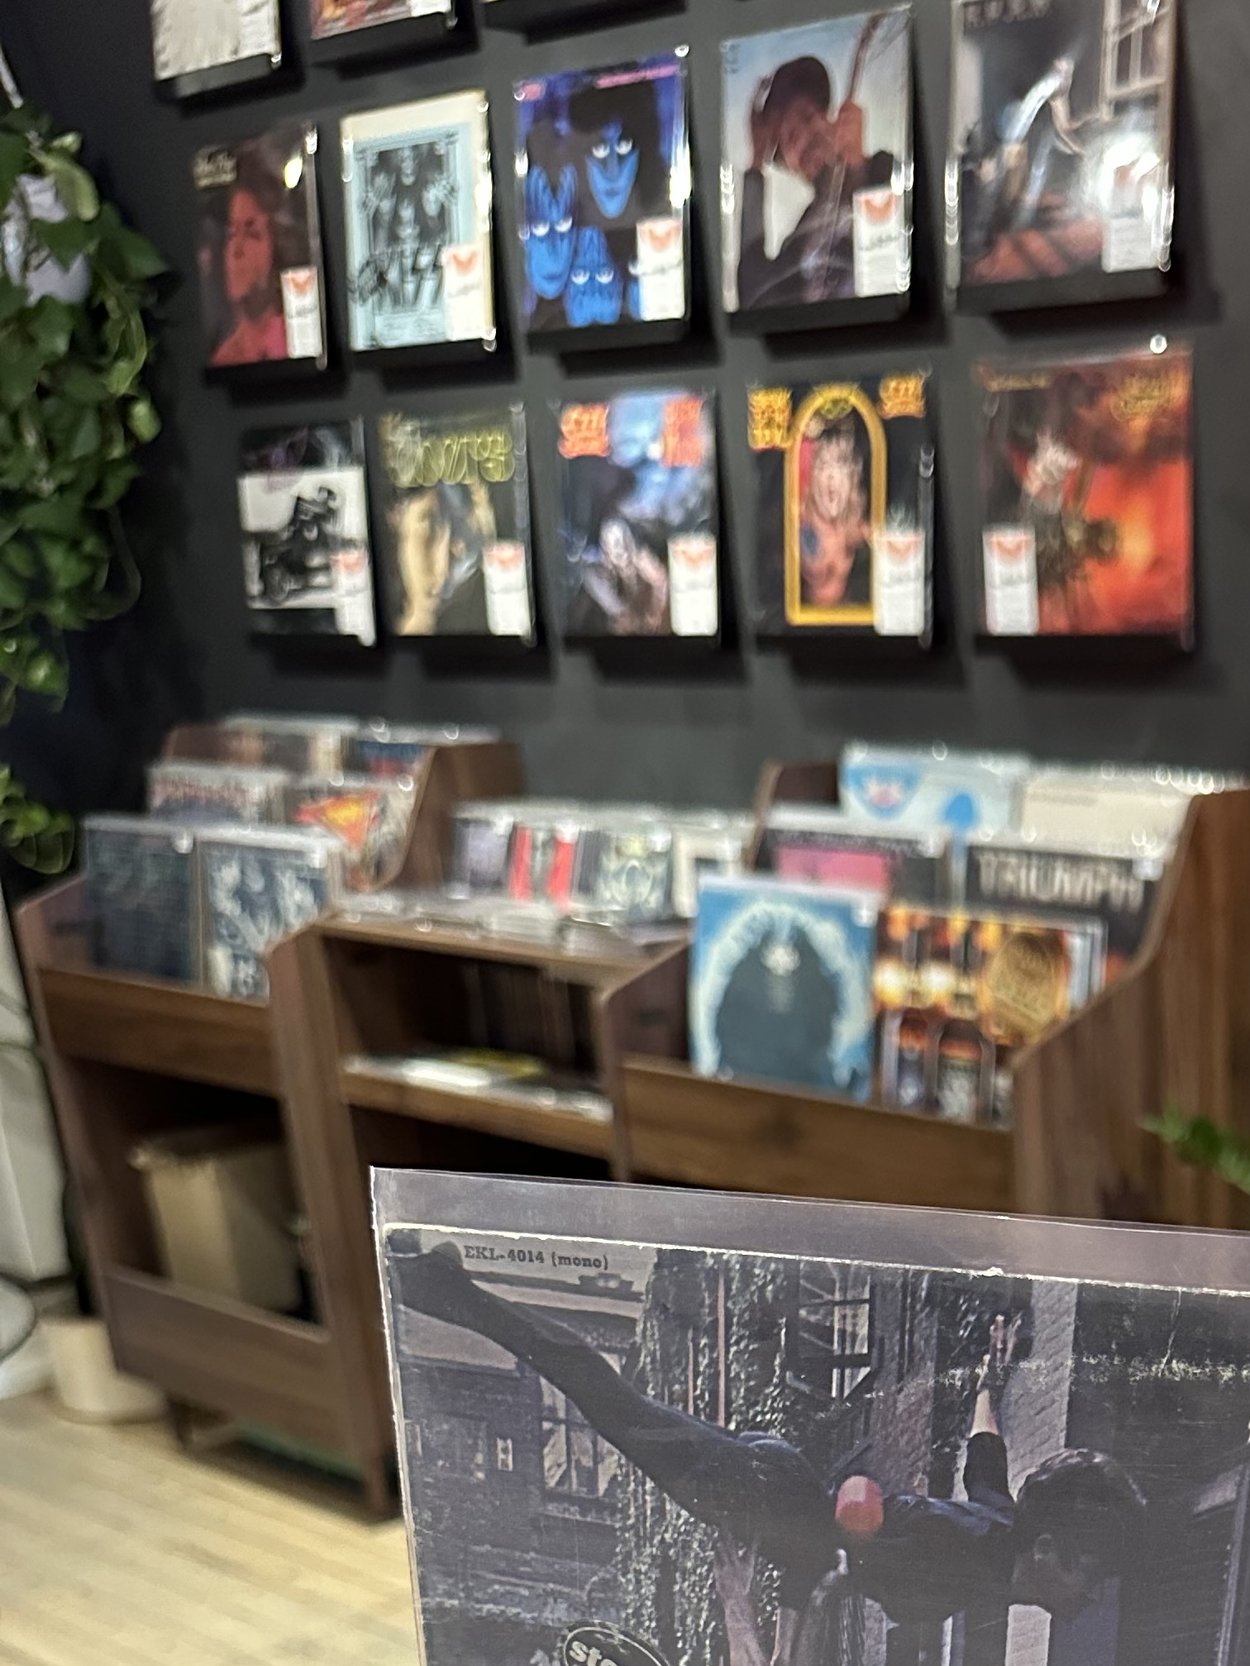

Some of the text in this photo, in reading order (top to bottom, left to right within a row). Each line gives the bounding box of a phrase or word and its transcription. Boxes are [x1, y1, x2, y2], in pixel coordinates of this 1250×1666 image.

[979, 851, 1145, 914] TRIUMPH
[463, 1244, 609, 1271] EKL-4014 (mono)
